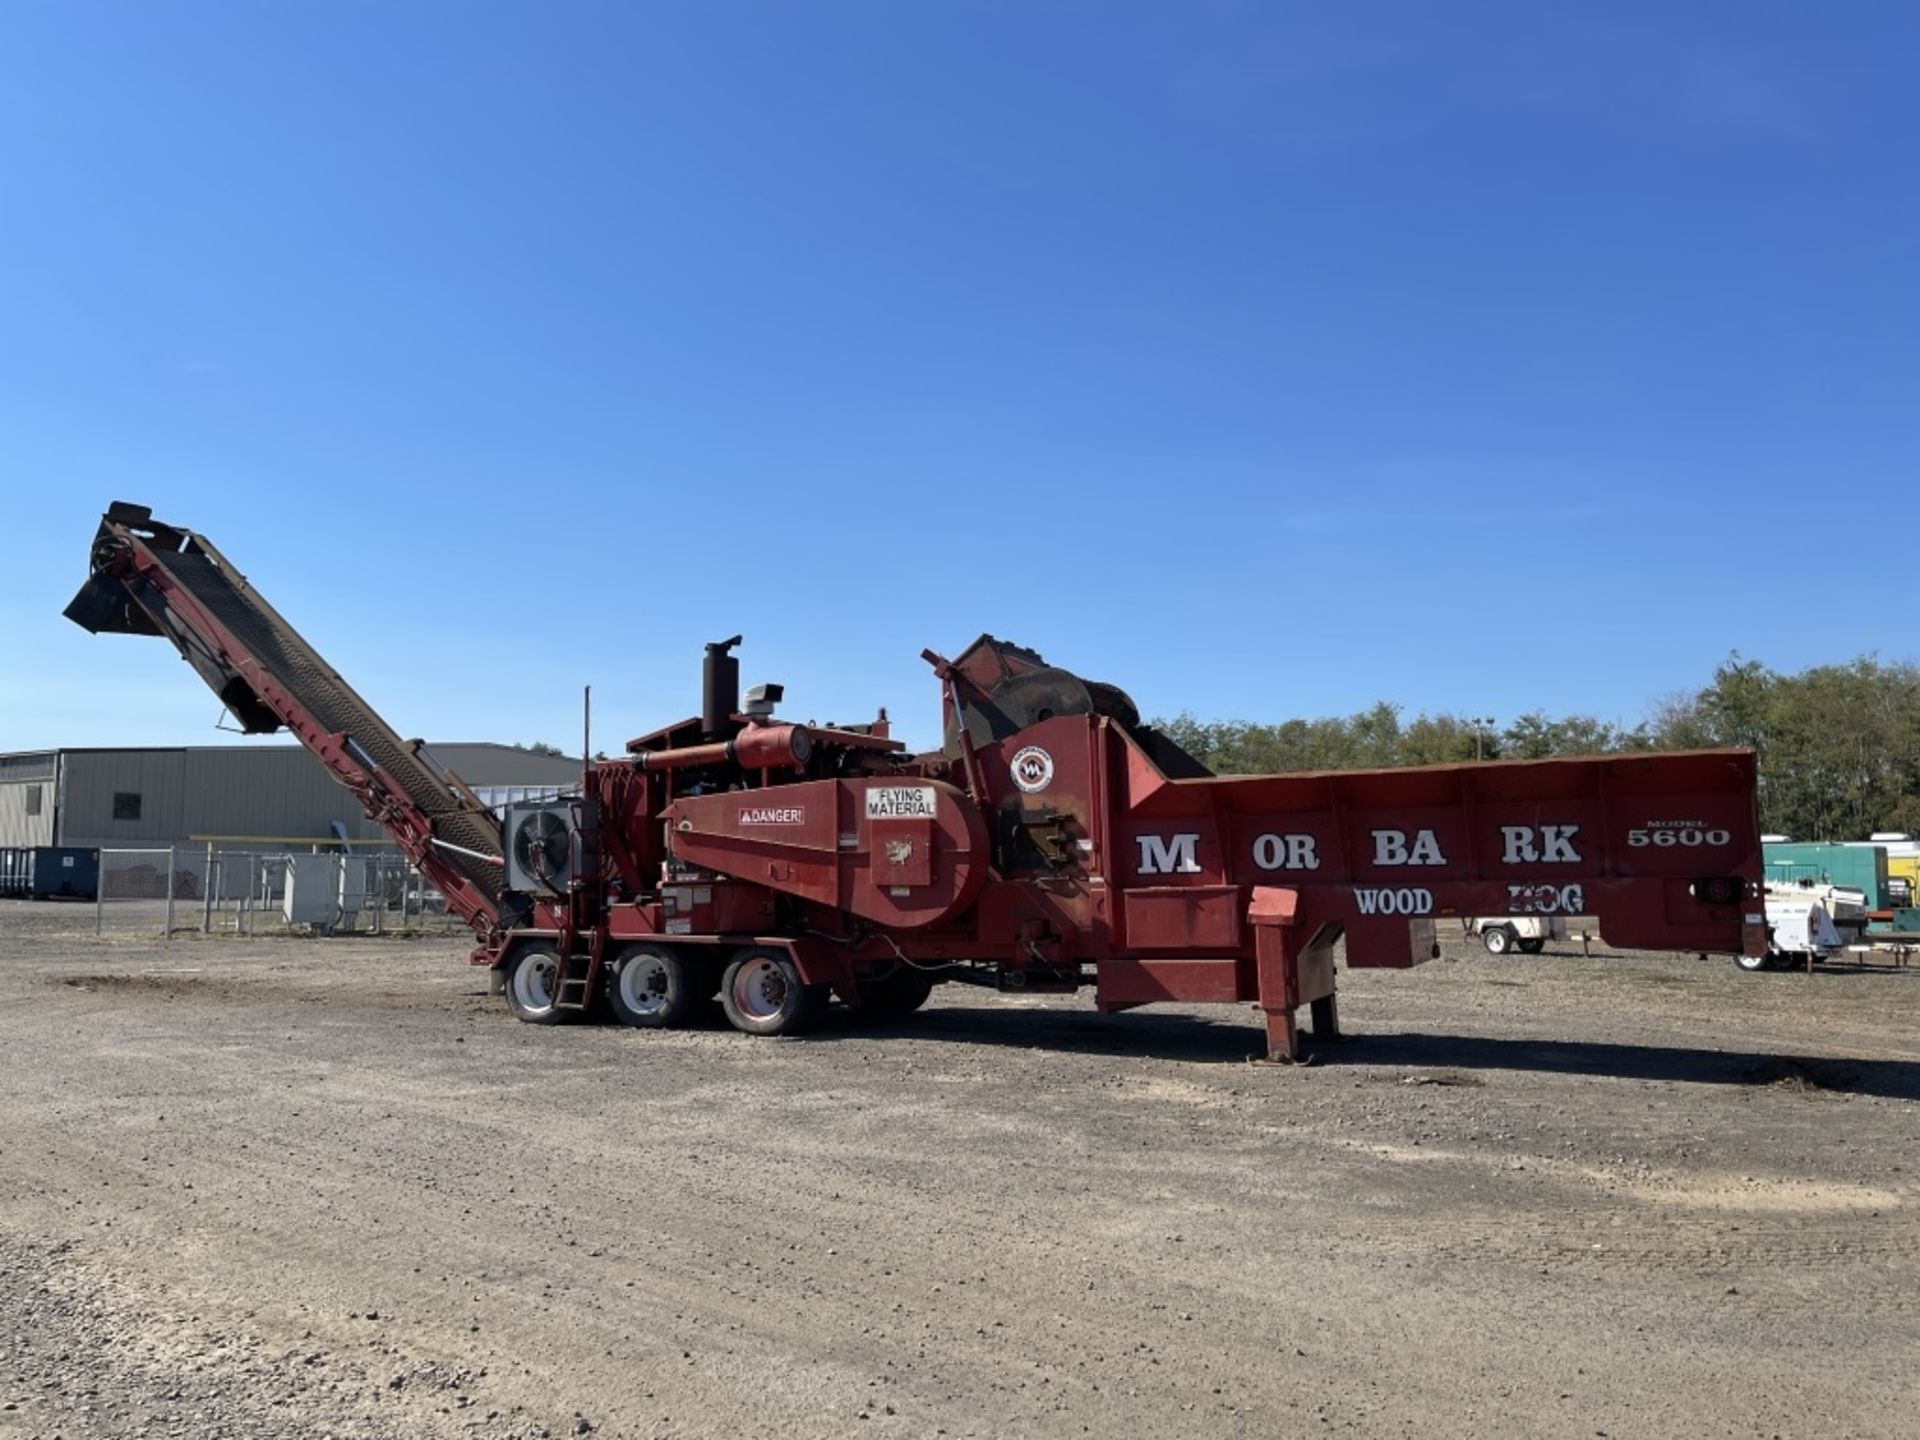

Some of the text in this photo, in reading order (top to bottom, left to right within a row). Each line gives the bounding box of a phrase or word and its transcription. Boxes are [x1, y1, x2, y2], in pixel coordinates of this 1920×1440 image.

[878, 789, 923, 802] FLYING
[751, 809, 802, 823] DANGER!
[868, 802, 934, 816] MATERIAL
[1626, 828, 1732, 847] 5600
[1252, 833, 1321, 870] OR
[1371, 829, 1447, 866] BA
[1500, 824, 1582, 864] RK
[1353, 888, 1434, 915] WOOD
